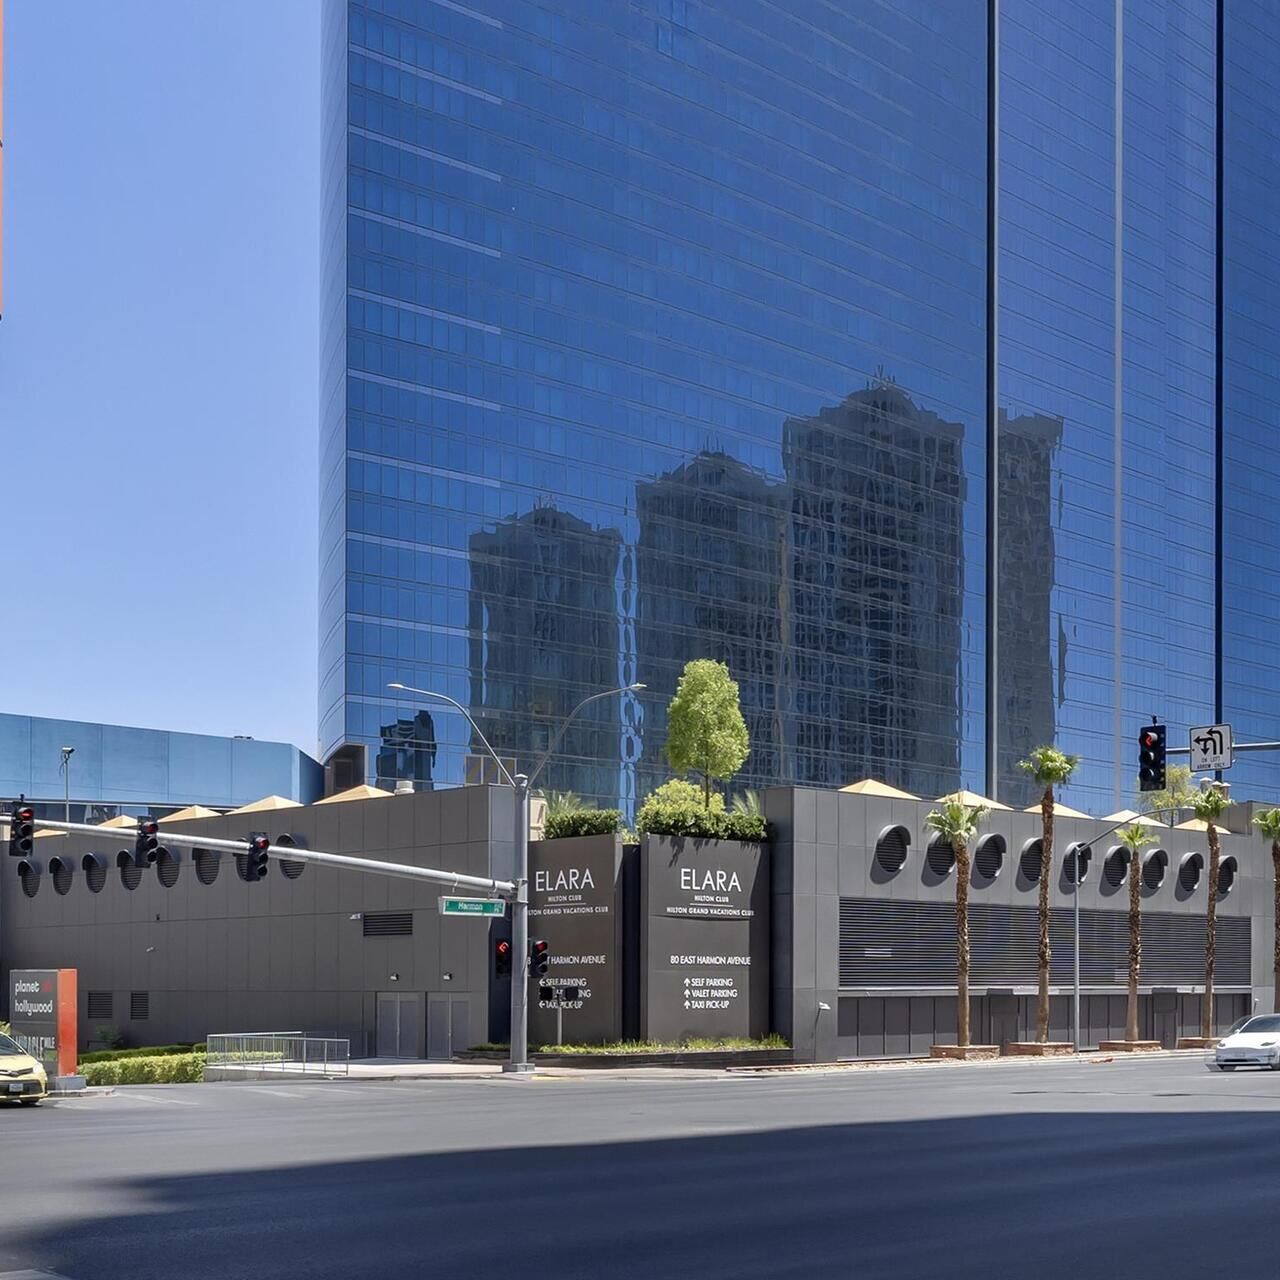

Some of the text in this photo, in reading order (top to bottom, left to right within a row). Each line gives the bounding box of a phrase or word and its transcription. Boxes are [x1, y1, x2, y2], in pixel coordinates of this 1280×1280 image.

[535, 868, 595, 892] ELARA
[681, 868, 742, 892] ELARA
[550, 956, 580, 965] HARMON
[580, 955, 606, 964] AVENUE
[670, 955, 752, 965] 80 EAST HARMON AVENUE
[691, 978, 733, 987] SELF PARKING
[15, 980, 40, 996] planet
[691, 989, 738, 998] VALET PARKING
[15, 1000, 53, 1016] hollywood
[691, 1000, 730, 1009] TAXI PICK-UP
